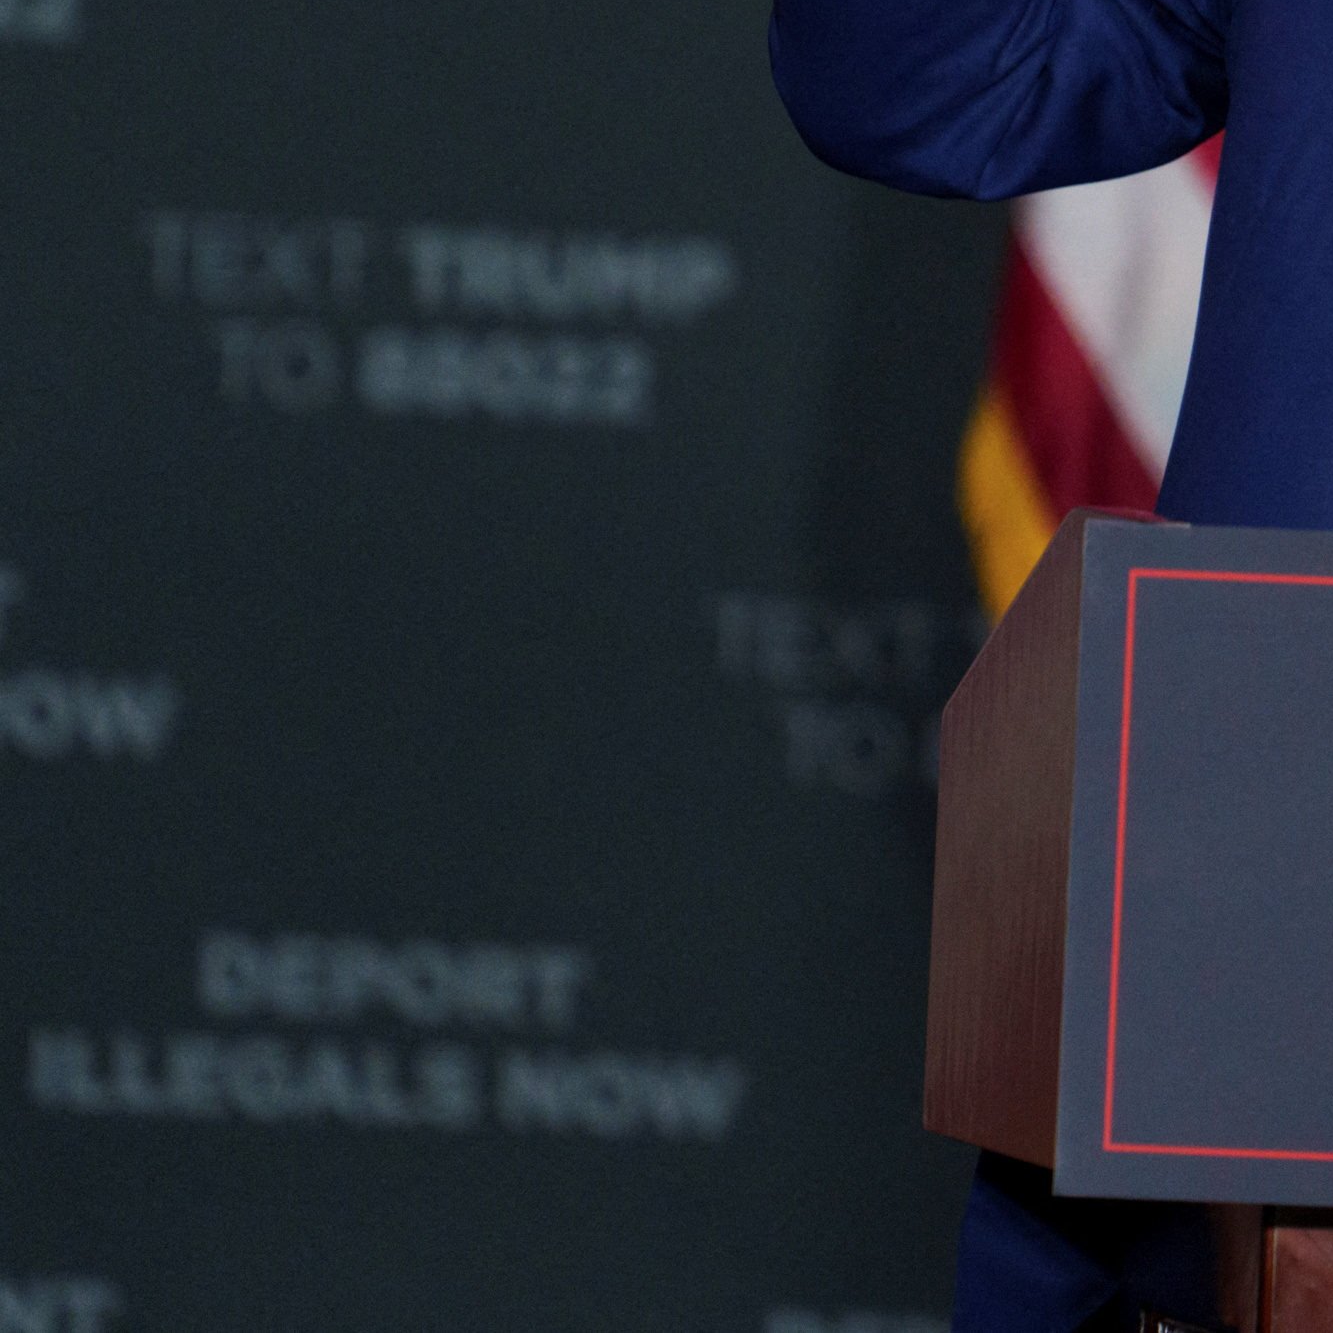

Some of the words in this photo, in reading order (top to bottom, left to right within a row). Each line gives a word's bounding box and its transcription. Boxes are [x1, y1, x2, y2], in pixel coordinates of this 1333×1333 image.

[146, 210, 370, 300] TEXT
[408, 226, 738, 316] TRUMP
[216, 320, 340, 412] TO
[360, 330, 654, 422] 88022
[198, 932, 588, 1026] DEPORT
[28, 1030, 478, 1130] ILLEGALS
[500, 1056, 744, 1140] NOW
